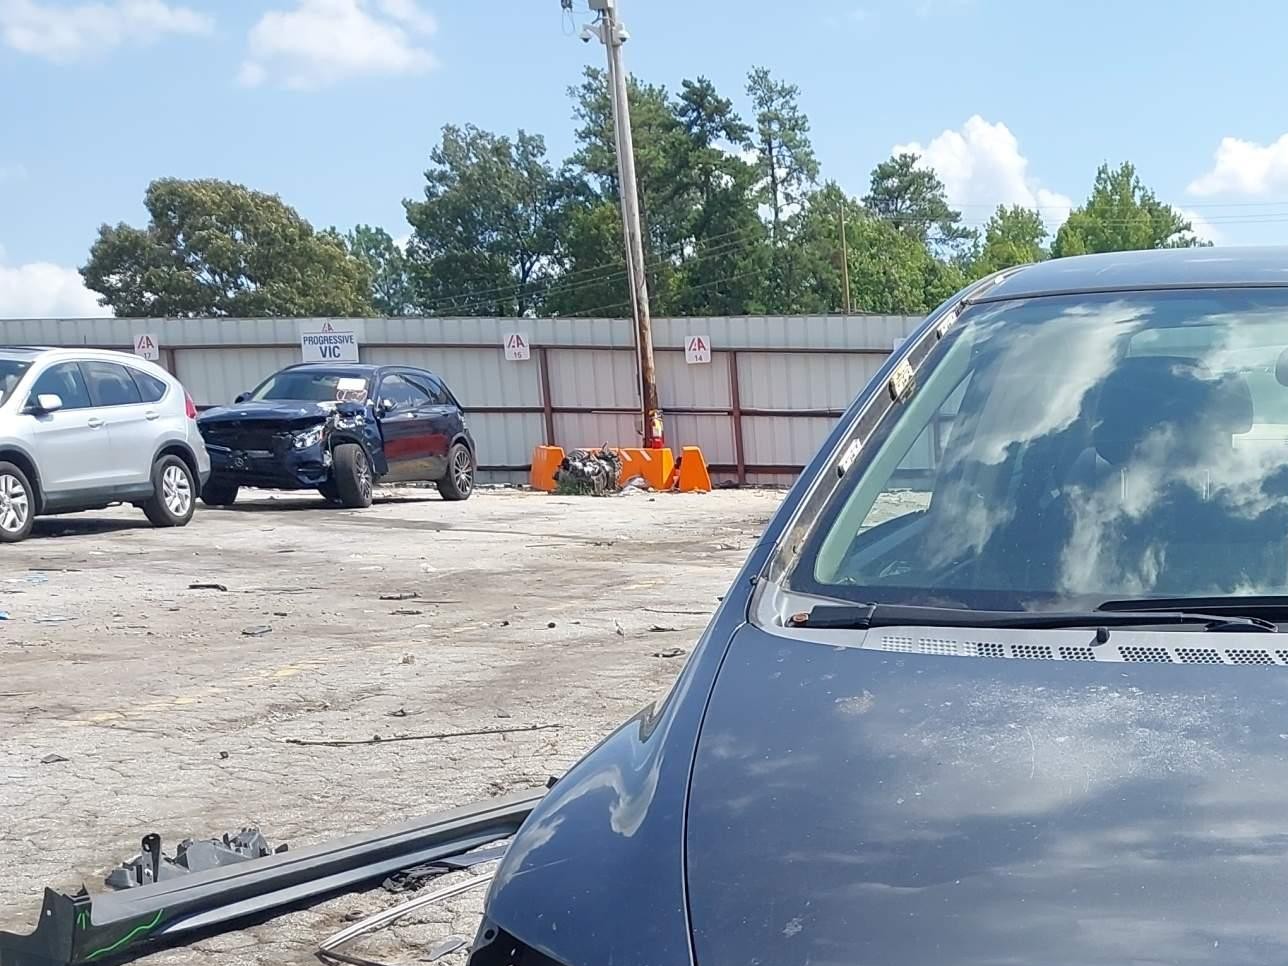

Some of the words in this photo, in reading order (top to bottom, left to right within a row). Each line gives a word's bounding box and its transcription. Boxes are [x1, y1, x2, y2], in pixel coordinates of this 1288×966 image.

[303, 335, 355, 345] PROGRESSIVE
[319, 345, 341, 359] VIC
[694, 354, 703, 362] 14
